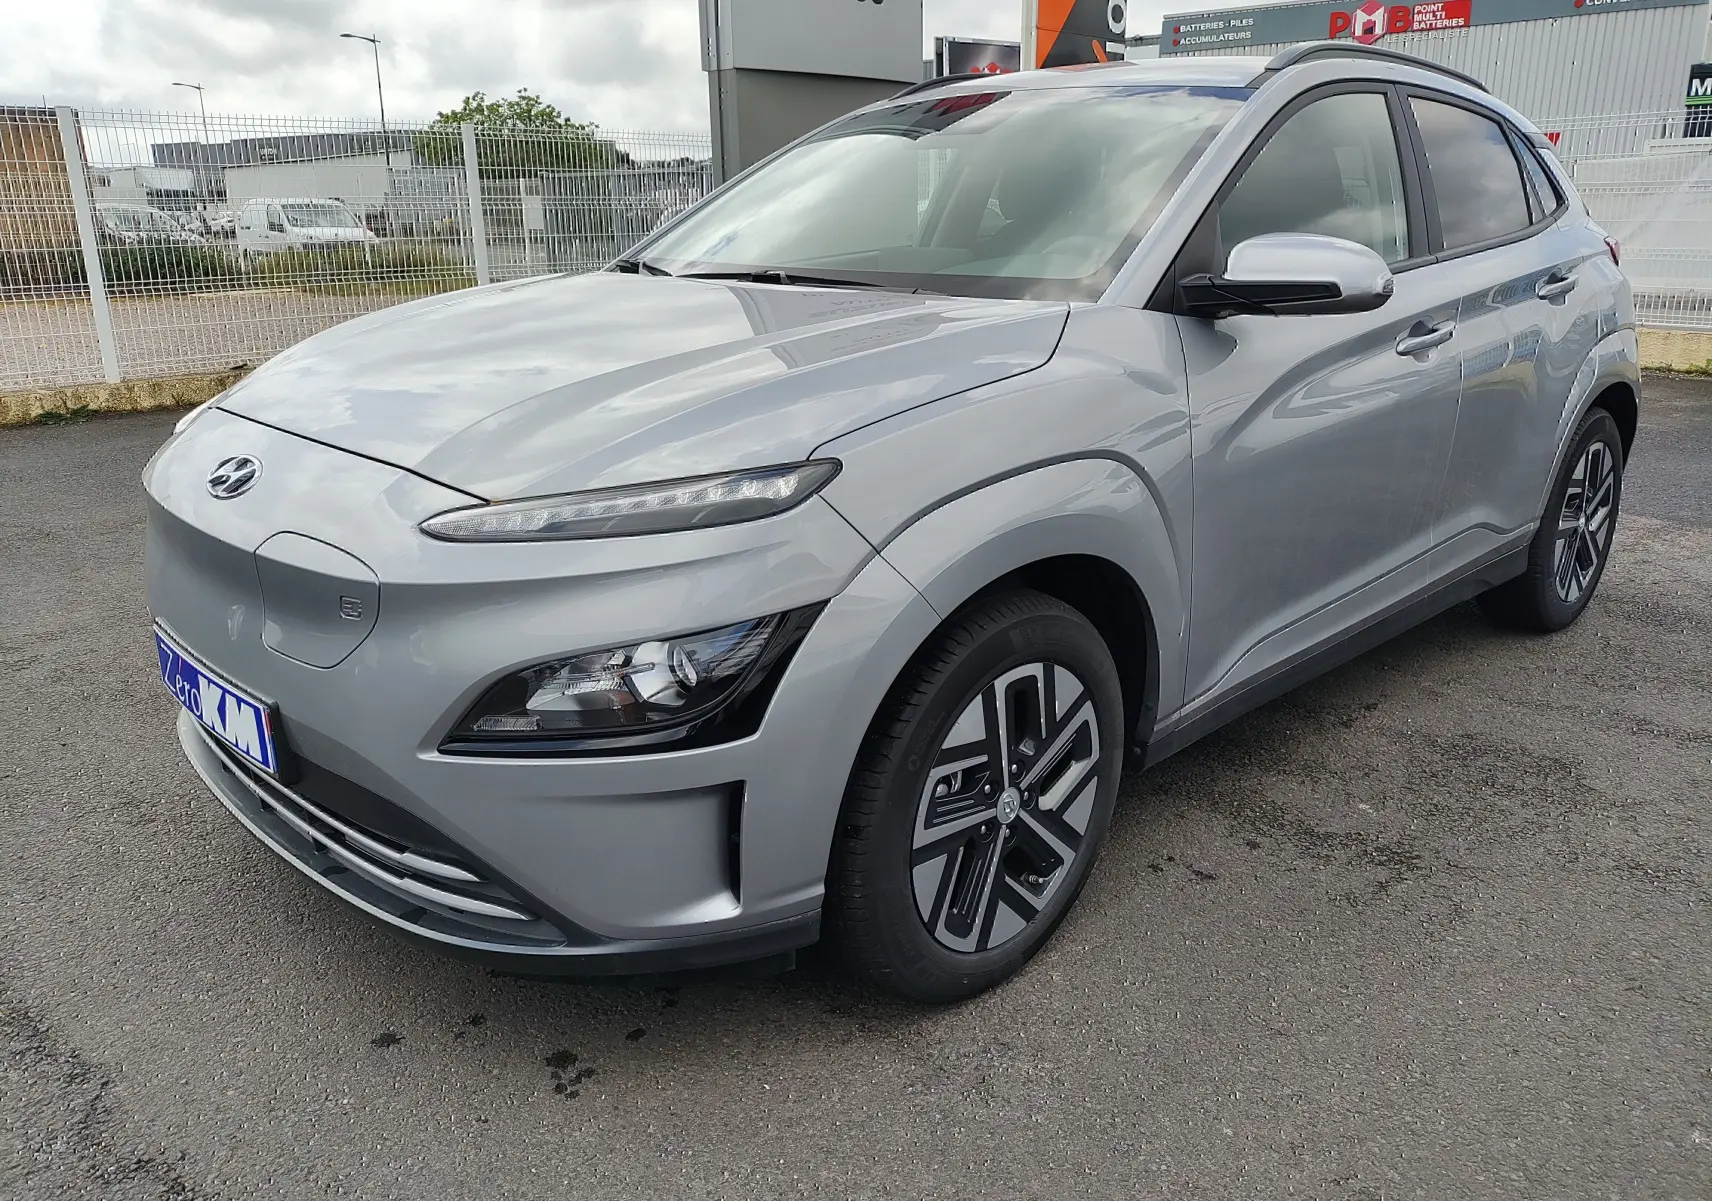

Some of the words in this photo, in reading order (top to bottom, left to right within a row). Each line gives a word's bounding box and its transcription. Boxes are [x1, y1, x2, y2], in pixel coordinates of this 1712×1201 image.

[1414, 3, 1444, 13] POINT
[1414, 11, 1445, 22] MULTI
[1180, 21, 1224, 33] BATTERIES
[1230, 18, 1254, 27] PILES
[1413, 18, 1465, 30] BATTERIES
[1180, 31, 1252, 45] ACCUMULATEURS
